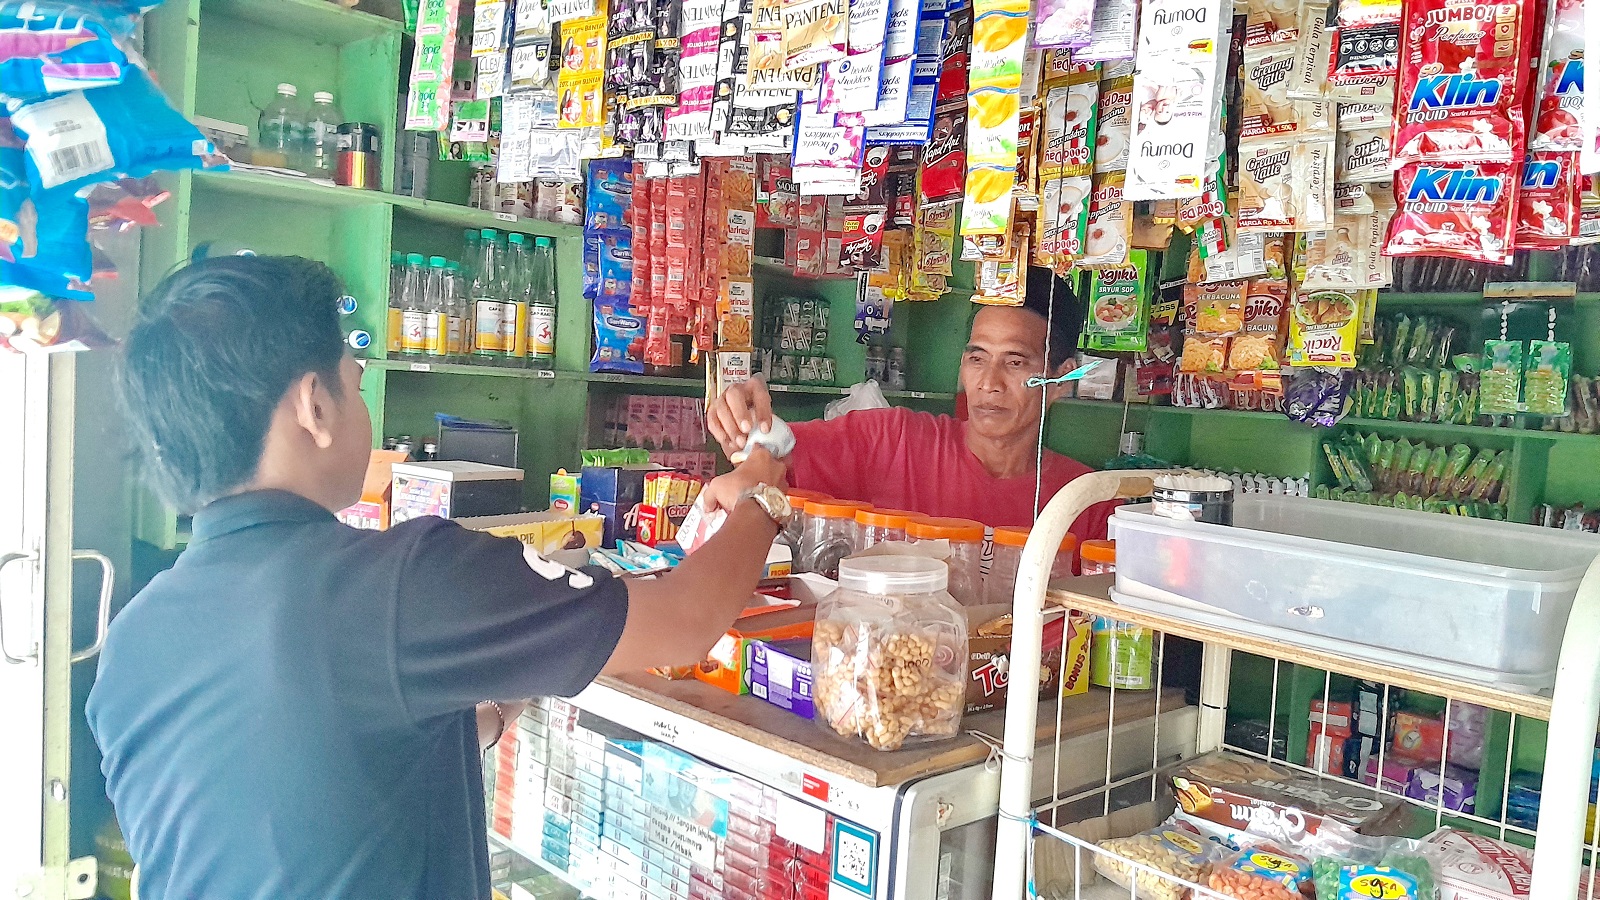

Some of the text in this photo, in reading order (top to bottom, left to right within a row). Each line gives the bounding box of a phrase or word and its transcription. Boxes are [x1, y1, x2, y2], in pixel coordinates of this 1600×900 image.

[785, 2, 845, 30] PANTENE
[1154, 8, 1206, 25] Downy
[1426, 5, 1495, 27] JUMBO!
[1246, 36, 1270, 47] HARGA
[1304, 16, 1325, 84] Gula Terpisah
[1250, 57, 1295, 80] Creamy
[1257, 70, 1286, 90] Latte
[1111, 92, 1132, 105] Day
[1408, 73, 1501, 111] Klin
[1407, 109, 1449, 123] LIQUID
[1241, 124, 1266, 138] HARGA
[1266, 126, 1277, 136] Rp
[1045, 147, 1090, 163] Good Day
[1141, 141, 1194, 159] Downy
[1246, 150, 1291, 171] Creamy
[1308, 149, 1321, 190] Terpisah
[1253, 163, 1282, 184] Latte
[1406, 168, 1501, 204] Klin
[1197, 201, 1224, 218] Good
[1404, 202, 1448, 214] LIQUID
[1262, 219, 1273, 227] Rp
[1055, 238, 1080, 253] Good
[1302, 335, 1342, 354] Racik
[972, 662, 1010, 697] To
[1065, 653, 1086, 690] BONUS
